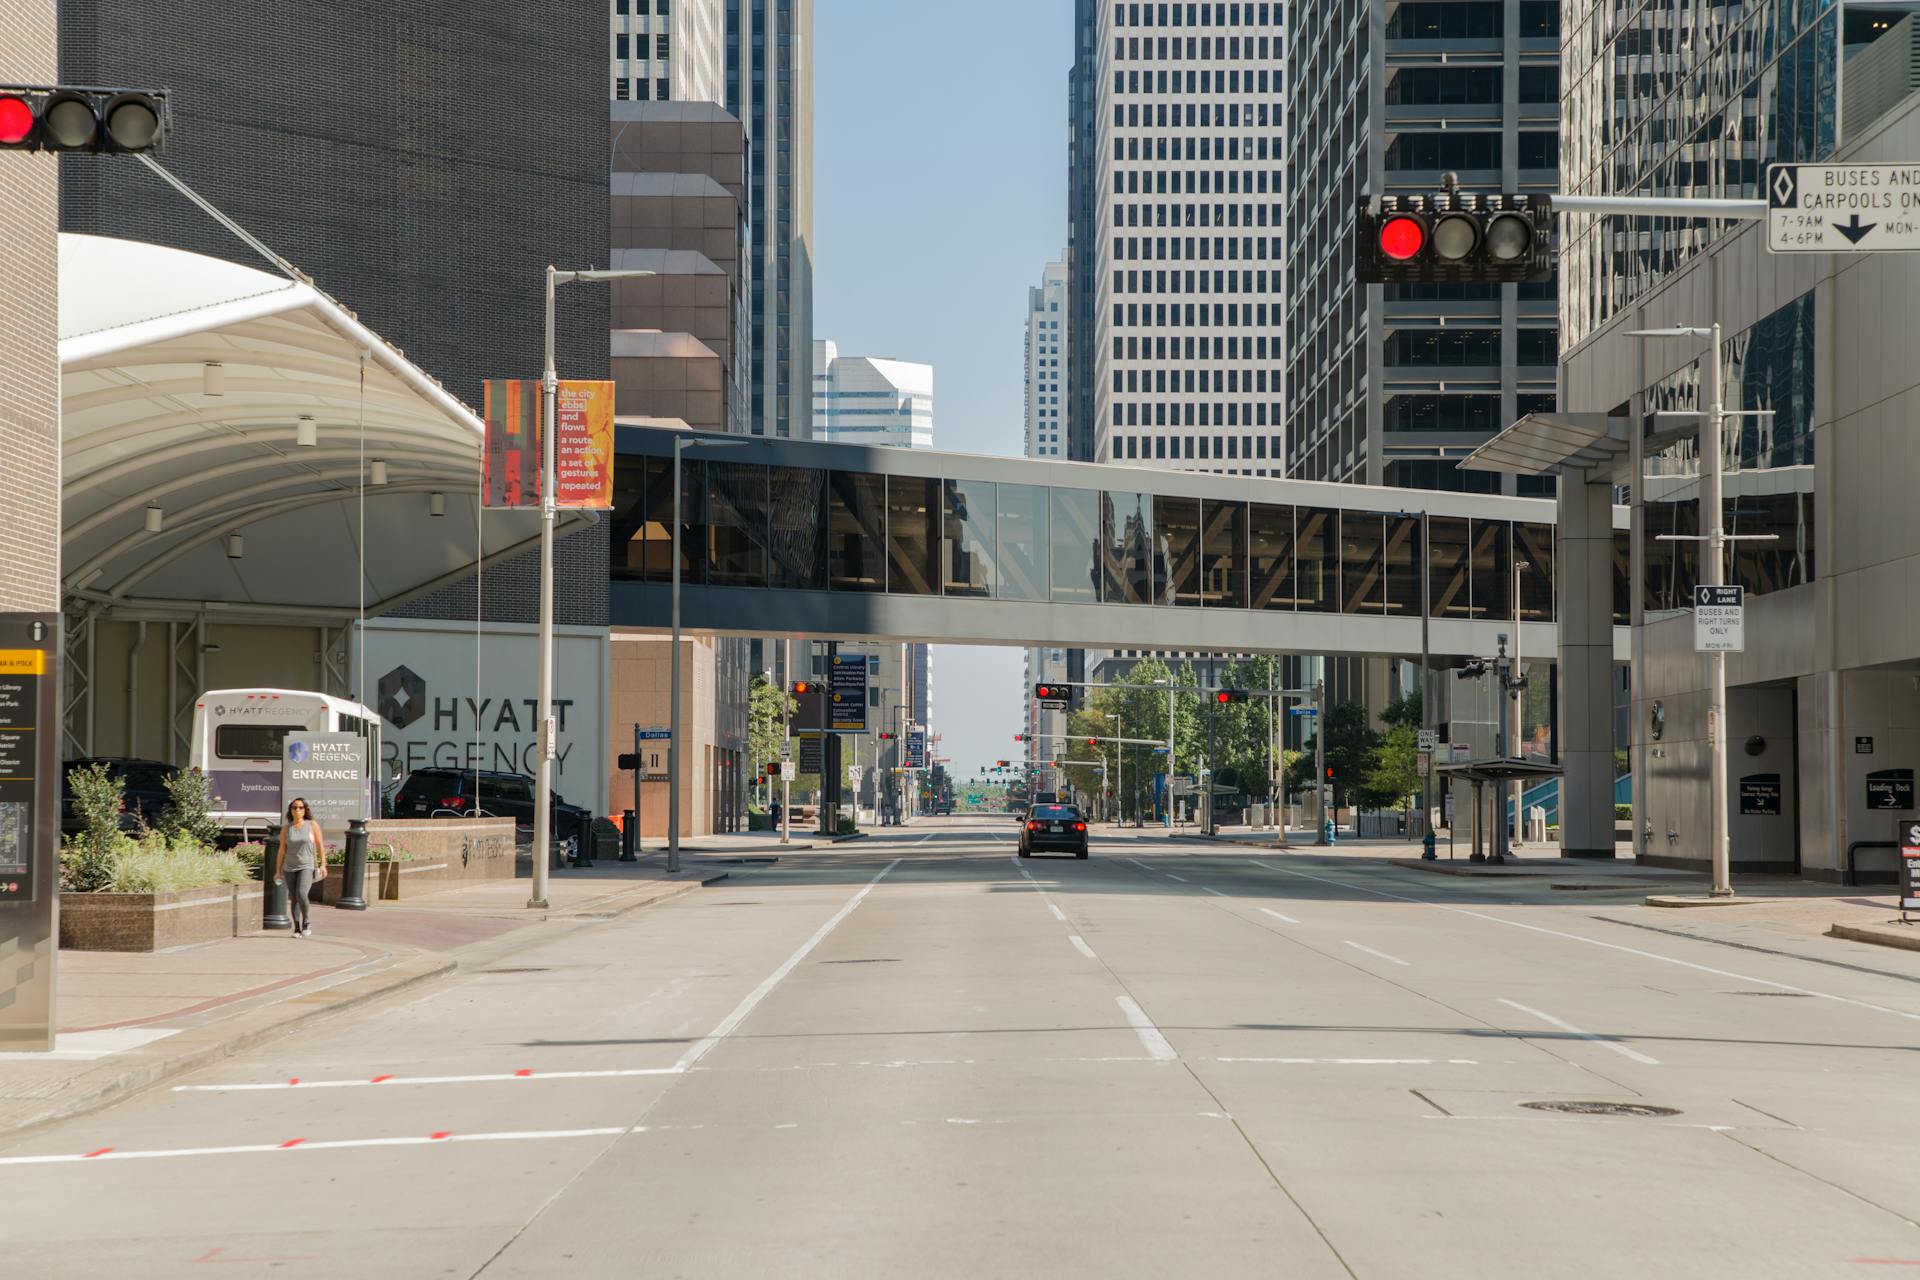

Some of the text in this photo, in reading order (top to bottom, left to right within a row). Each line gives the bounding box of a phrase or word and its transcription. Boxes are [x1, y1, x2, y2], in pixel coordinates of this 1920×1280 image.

[1825, 169, 1920, 186] BUSES AND
[1803, 193, 1892, 208] CARPOOLS
[1781, 215, 1823, 227] 7-9AM
[1780, 232, 1823, 244] 4-6PM
[561, 388, 595, 400] the city
[561, 412, 578, 421] and
[561, 422, 585, 431] flows
[569, 459, 582, 467] set
[584, 458, 595, 467] of
[561, 469, 599, 478] gestures
[561, 481, 601, 490] repeated
[1698, 608, 1740, 616] BUSES AND
[1709, 627, 1728, 635] ONLY
[229, 707, 313, 716] HYATT REGENCY
[434, 697, 574, 732] HYATT
[312, 743, 351, 752] HYATT
[312, 752, 361, 761] REGENCY
[381, 740, 574, 775] REGENCY
[292, 769, 359, 780] ENTRANCE
[241, 783, 280, 792] hyatt.com
[1869, 783, 1893, 794] Loading
